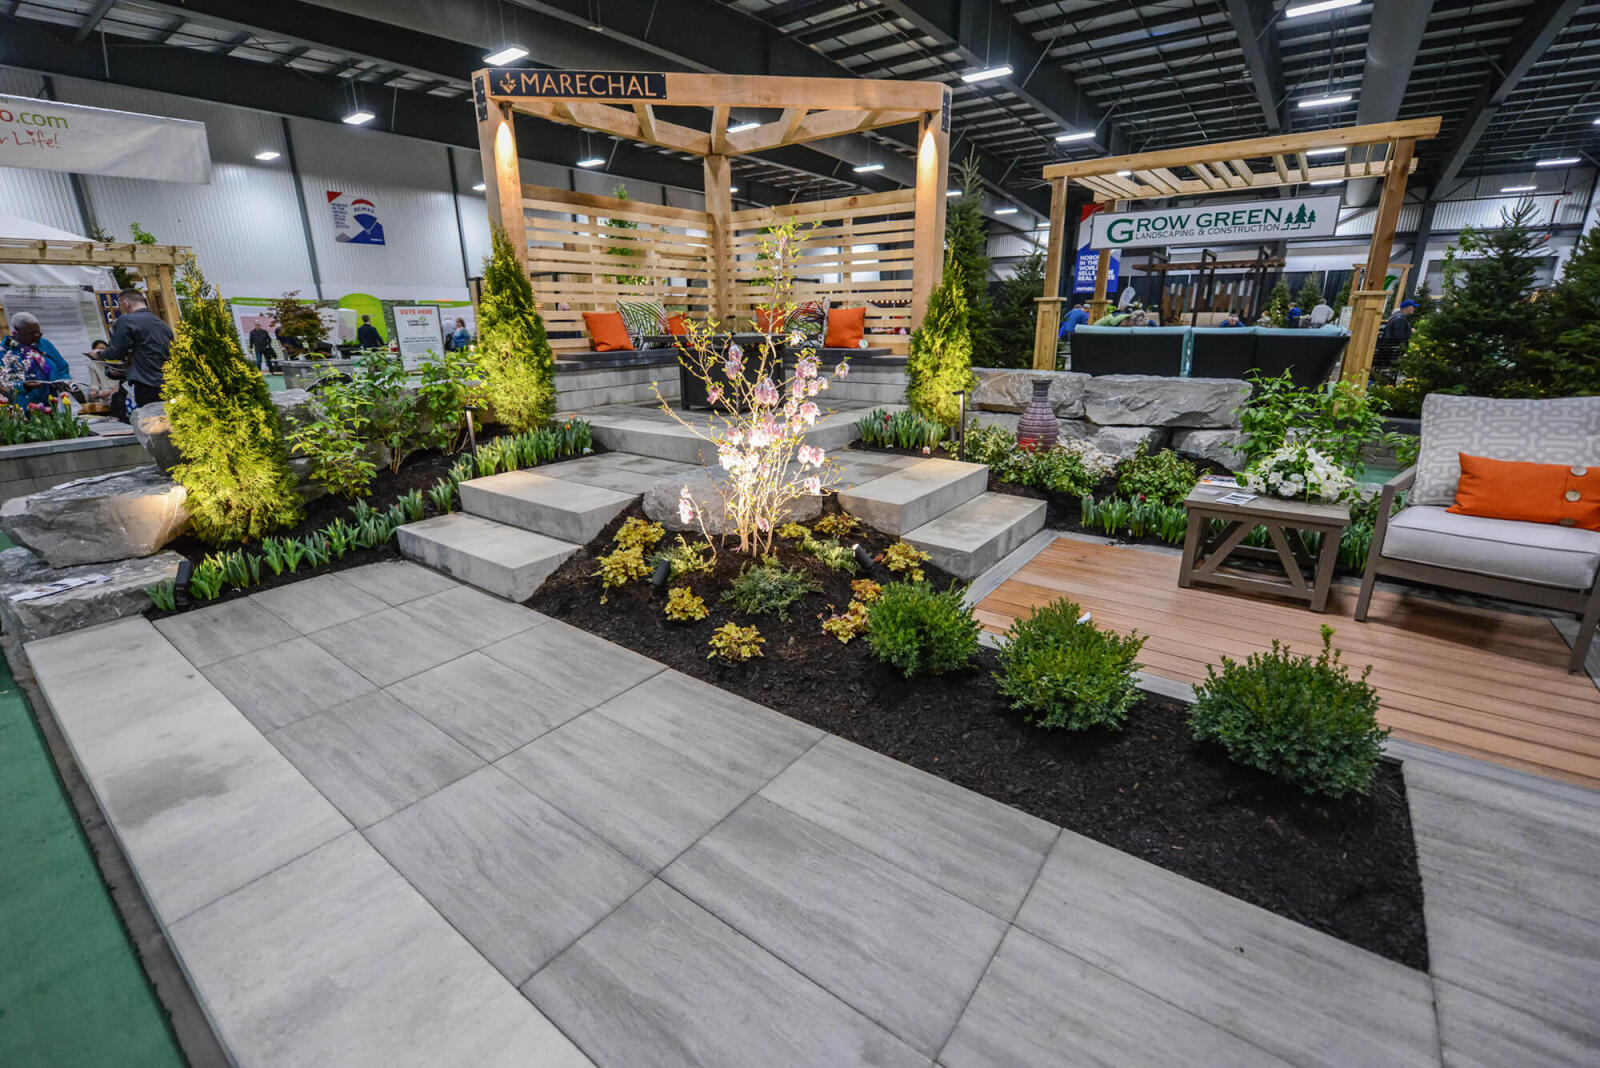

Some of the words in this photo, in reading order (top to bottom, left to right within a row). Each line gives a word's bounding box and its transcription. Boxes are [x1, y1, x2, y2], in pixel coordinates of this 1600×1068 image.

[520, 72, 657, 97] MARECHAL
[12, 130, 60, 149] Life!
[1106, 214, 1191, 244] GROW
[1195, 207, 1283, 228] GREEN
[1135, 228, 1195, 240] LANDSCAPING
[1198, 228, 1205, 236] &
[1208, 223, 1280, 235] CONSTRUCTION
